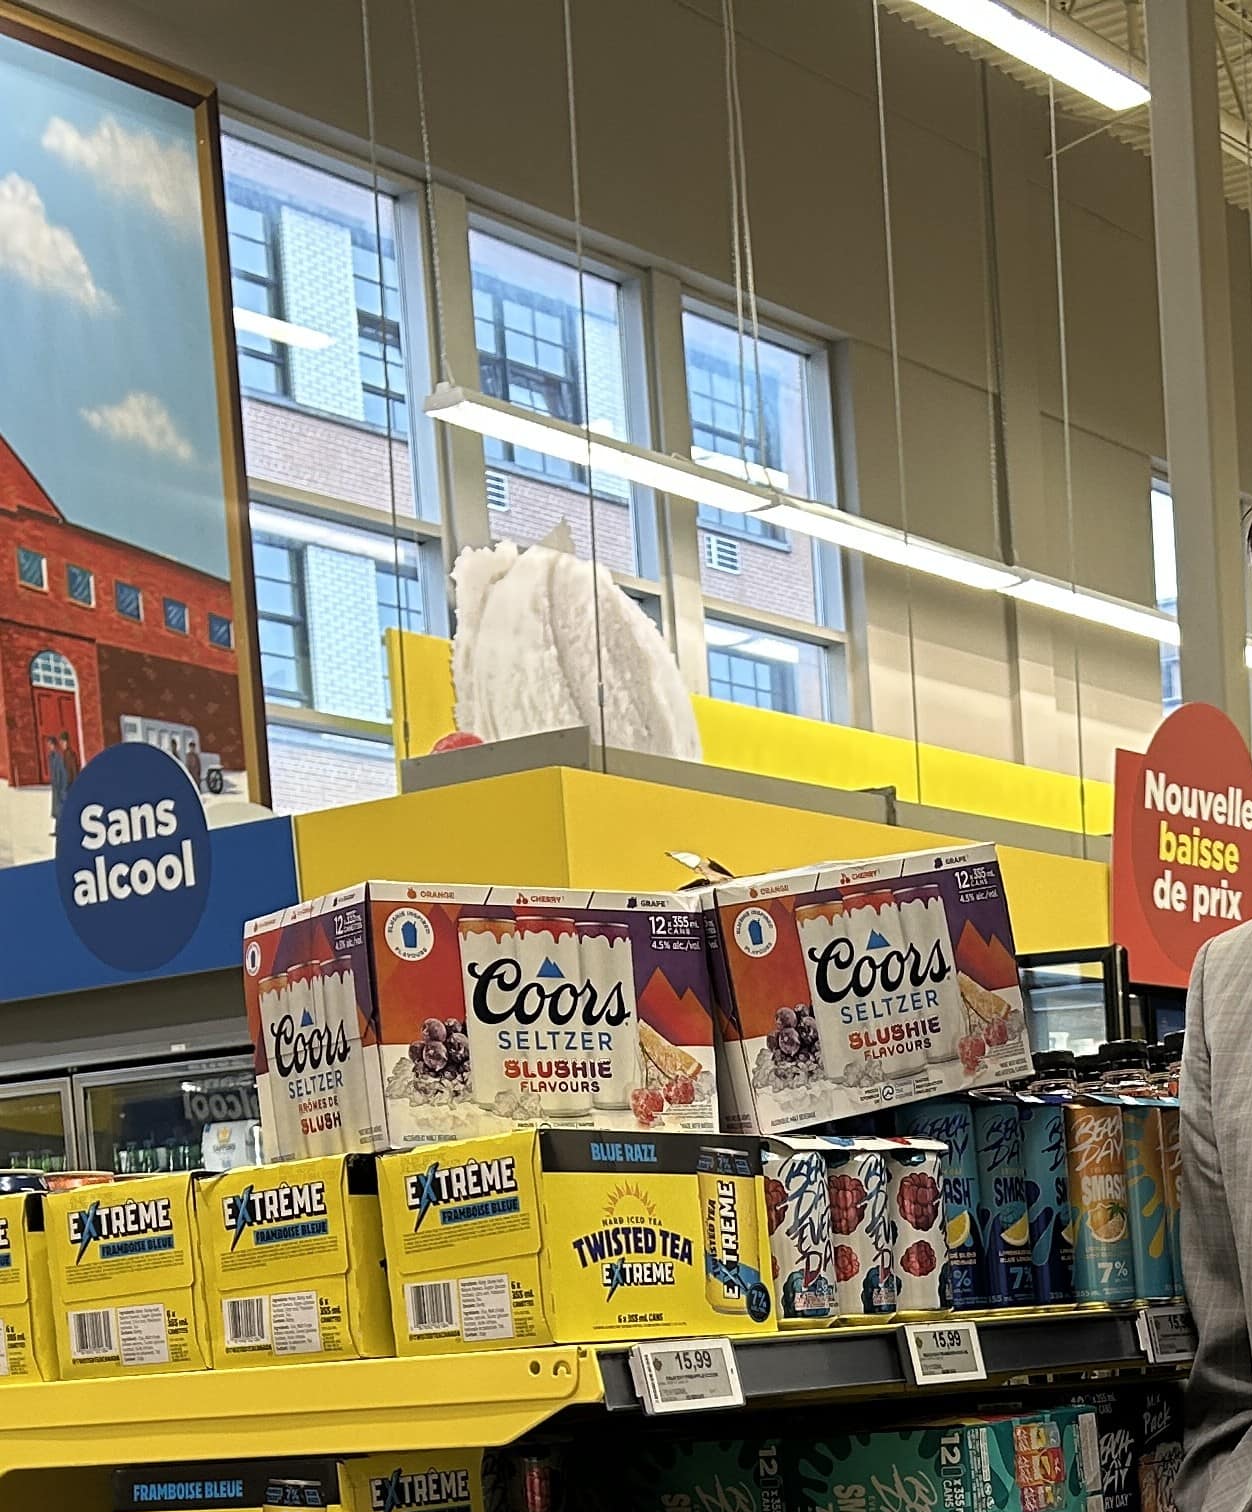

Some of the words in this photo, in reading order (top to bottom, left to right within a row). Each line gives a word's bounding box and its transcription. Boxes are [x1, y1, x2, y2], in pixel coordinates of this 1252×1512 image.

[80, 798, 178, 850] Sans
[1159, 820, 1240, 874] baisse
[73, 839, 195, 906] alcool
[641, 900, 666, 908] GRAPE
[1153, 870, 1186, 912] de
[1192, 880, 1242, 922] prix
[649, 916, 666, 935] 12
[652, 940, 670, 950] 4.5%
[808, 937, 951, 1004] Coors
[468, 958, 631, 1027] Coors
[840, 990, 940, 1024] SELTZER
[498, 1031, 613, 1051] SELTZER
[848, 1016, 941, 1050] SLUSHIE
[271, 1014, 351, 1077] Coors
[864, 1038, 932, 1061] FLAVOURS
[504, 1060, 612, 1079] SLUSHIE
[288, 1069, 344, 1100] SELTZER
[521, 1081, 600, 1093] FLAVOURS
[328, 1095, 338, 1107] DE
[301, 1111, 342, 1135] SLUSH
[590, 1142, 621, 1162] BLUE
[623, 1143, 657, 1162] RAZZ
[404, 1157, 518, 1231] EXTRÊME
[222, 1182, 327, 1253] EXTRÊME
[442, 1204, 489, 1224] FRAMBOISE
[490, 1200, 520, 1214] BLEUE
[602, 1218, 624, 1227] HARD
[626, 1217, 644, 1225] ICED
[646, 1217, 663, 1226] TEA
[69, 1198, 172, 1265] EXTRÊME
[572, 1227, 657, 1268] TWISTED
[660, 1231, 694, 1266] TEA
[601, 1258, 675, 1303] EXTREME
[1099, 1261, 1128, 1285] 7%
[932, 1330, 962, 1349] 15,99
[674, 1350, 712, 1371] 15,99
[133, 1483, 202, 1502] FRAMBOISE
[204, 1480, 243, 1498] BLEUE
